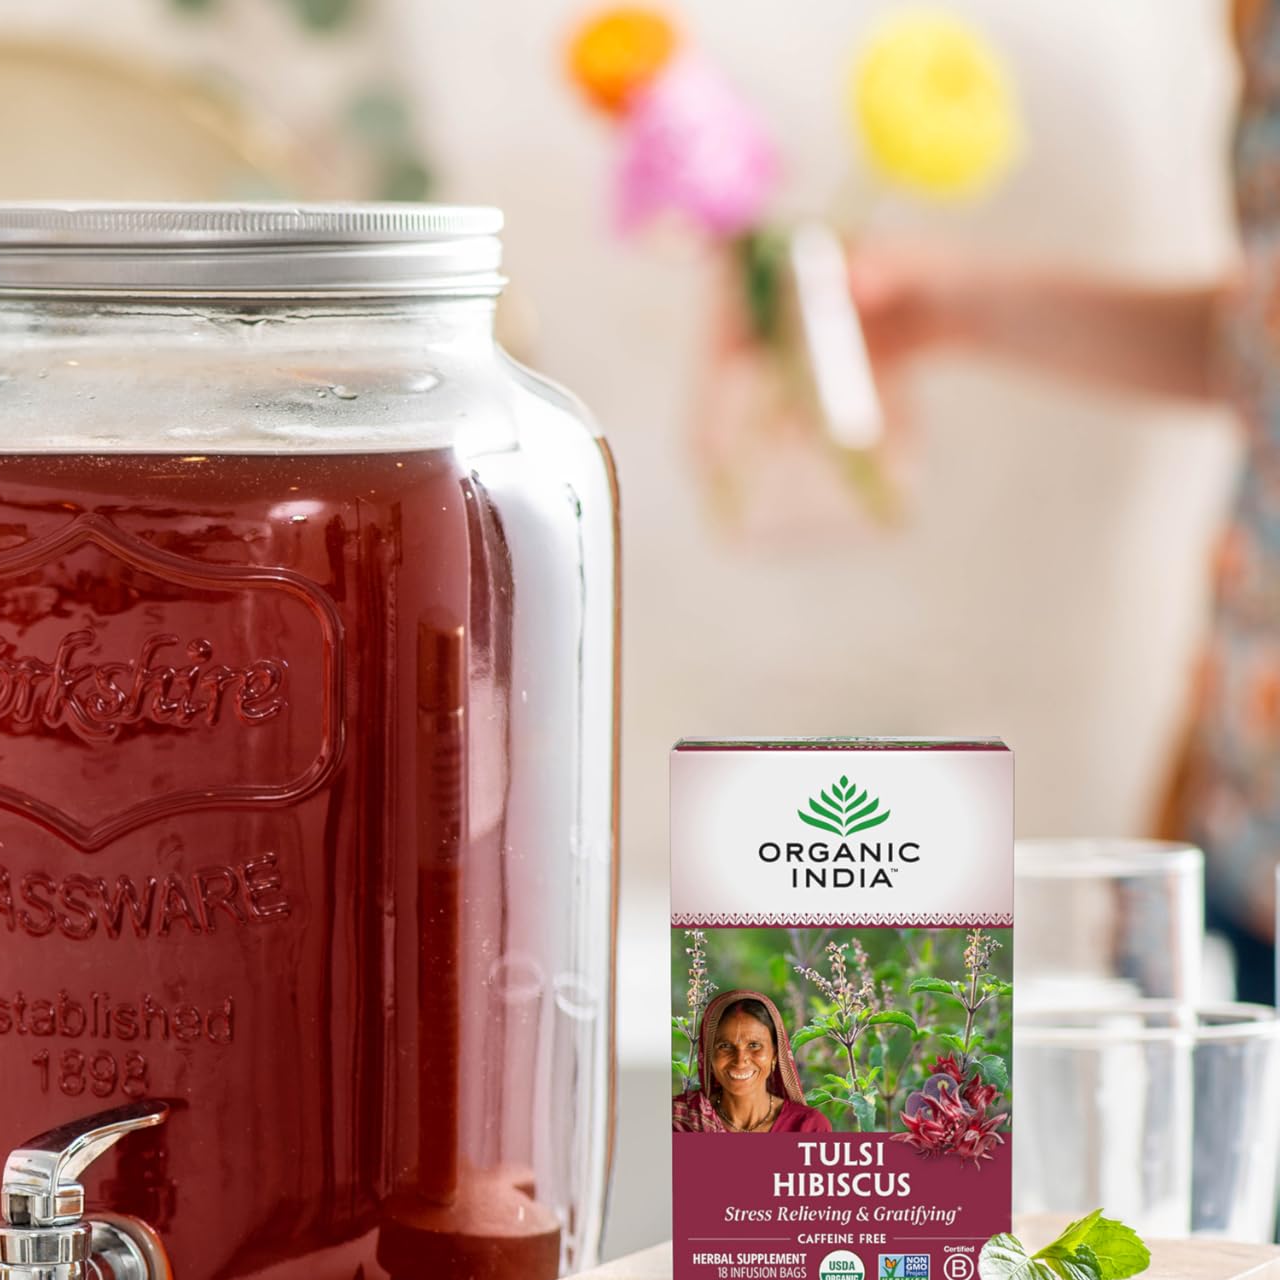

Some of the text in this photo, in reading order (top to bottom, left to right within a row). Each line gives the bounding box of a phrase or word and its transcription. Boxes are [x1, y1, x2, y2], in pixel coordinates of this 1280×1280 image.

[758, 842, 921, 863] ORGANIC
[798, 1142, 885, 1167] TULSI
[773, 1173, 911, 1197] HIBISCUS
[724, 1206, 771, 1222] Stress
[777, 1206, 852, 1225] Relieving
[856, 1206, 869, 1222] &
[797, 1233, 887, 1244] CAFFEINE FREE
[693, 1253, 807, 1264] HERBAL SUPPLEMENT
[906, 1256, 927, 1264] NON
[829, 1261, 855, 1271] USDA
[718, 1267, 807, 1278] 18 INFUSION BAGS
